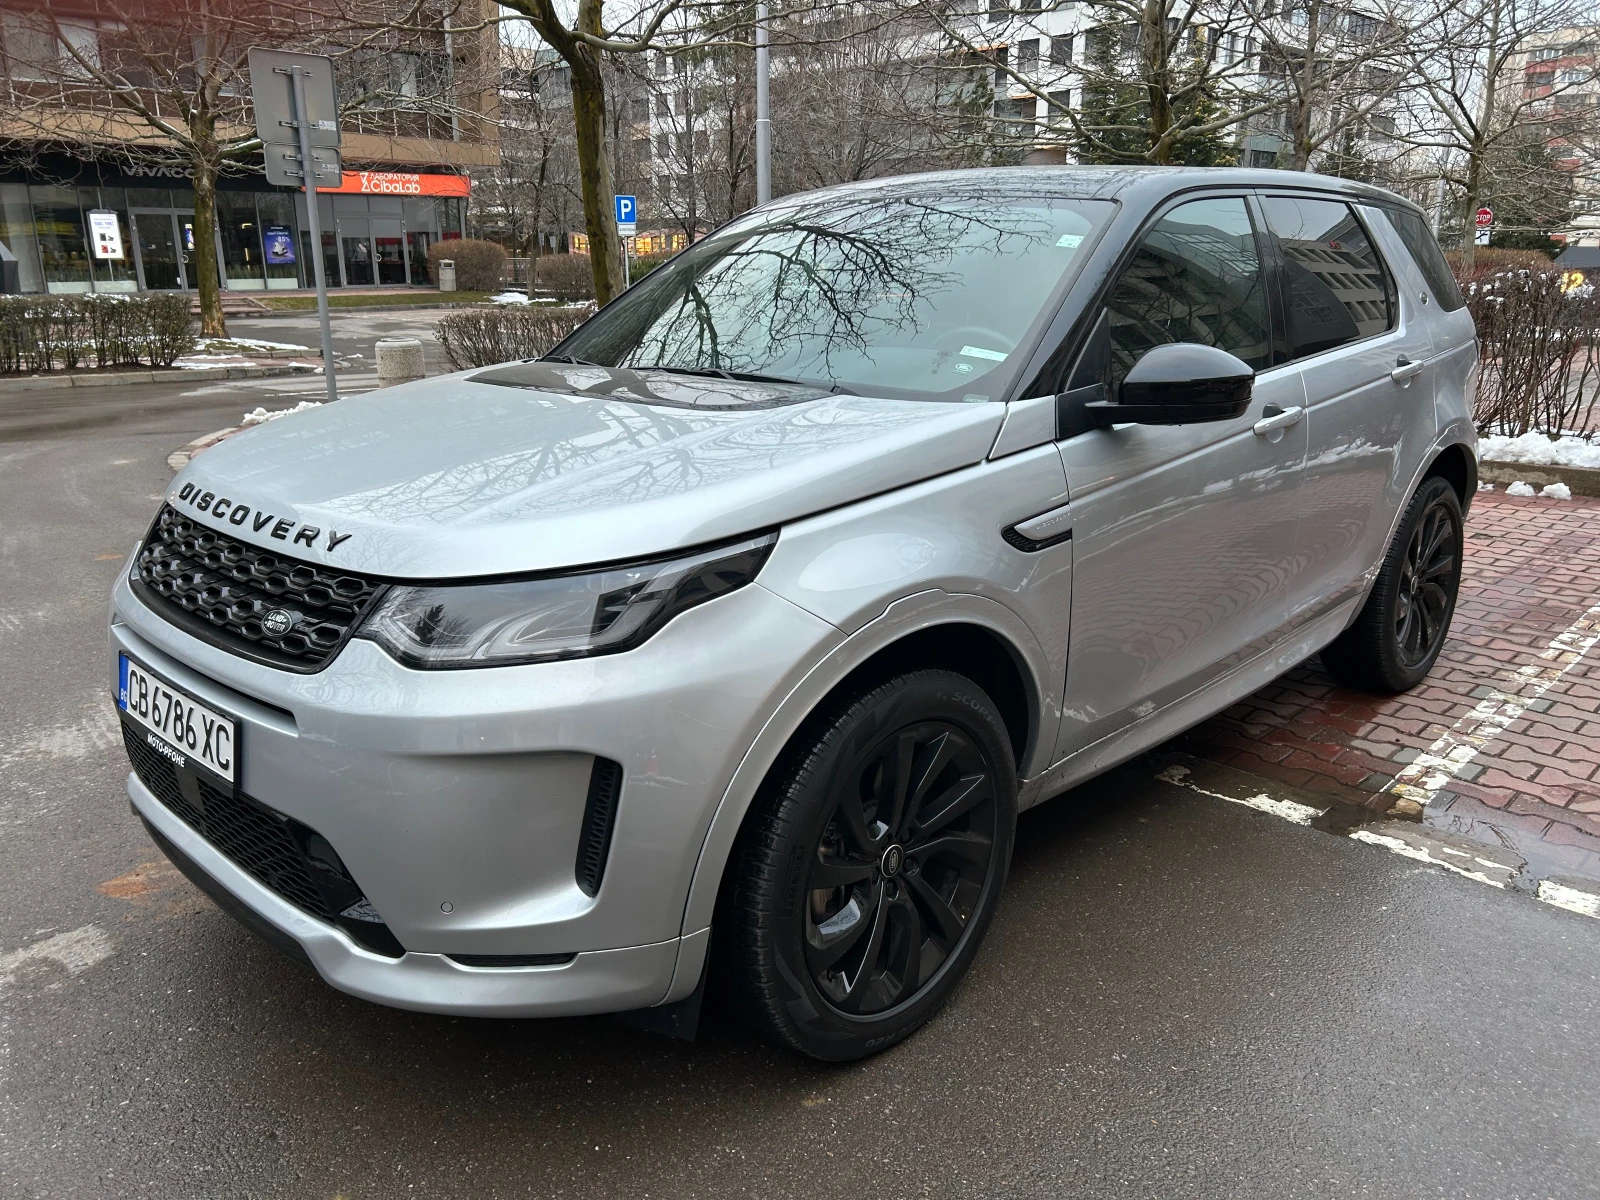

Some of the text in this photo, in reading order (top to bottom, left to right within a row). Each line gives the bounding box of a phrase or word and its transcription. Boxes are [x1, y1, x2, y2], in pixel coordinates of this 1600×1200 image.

[122, 165, 195, 179] VIVACO
[370, 173, 420, 182] ЛАБОРАТОРИЯ
[370, 179, 421, 194] CibaLab
[620, 199, 632, 220] P
[178, 482, 353, 552] DISCOVERY
[267, 612, 286, 622] LAND
[266, 620, 286, 632] ROVER
[120, 687, 128, 703] BG
[147, 733, 187, 768] MOTO-PFOHE
